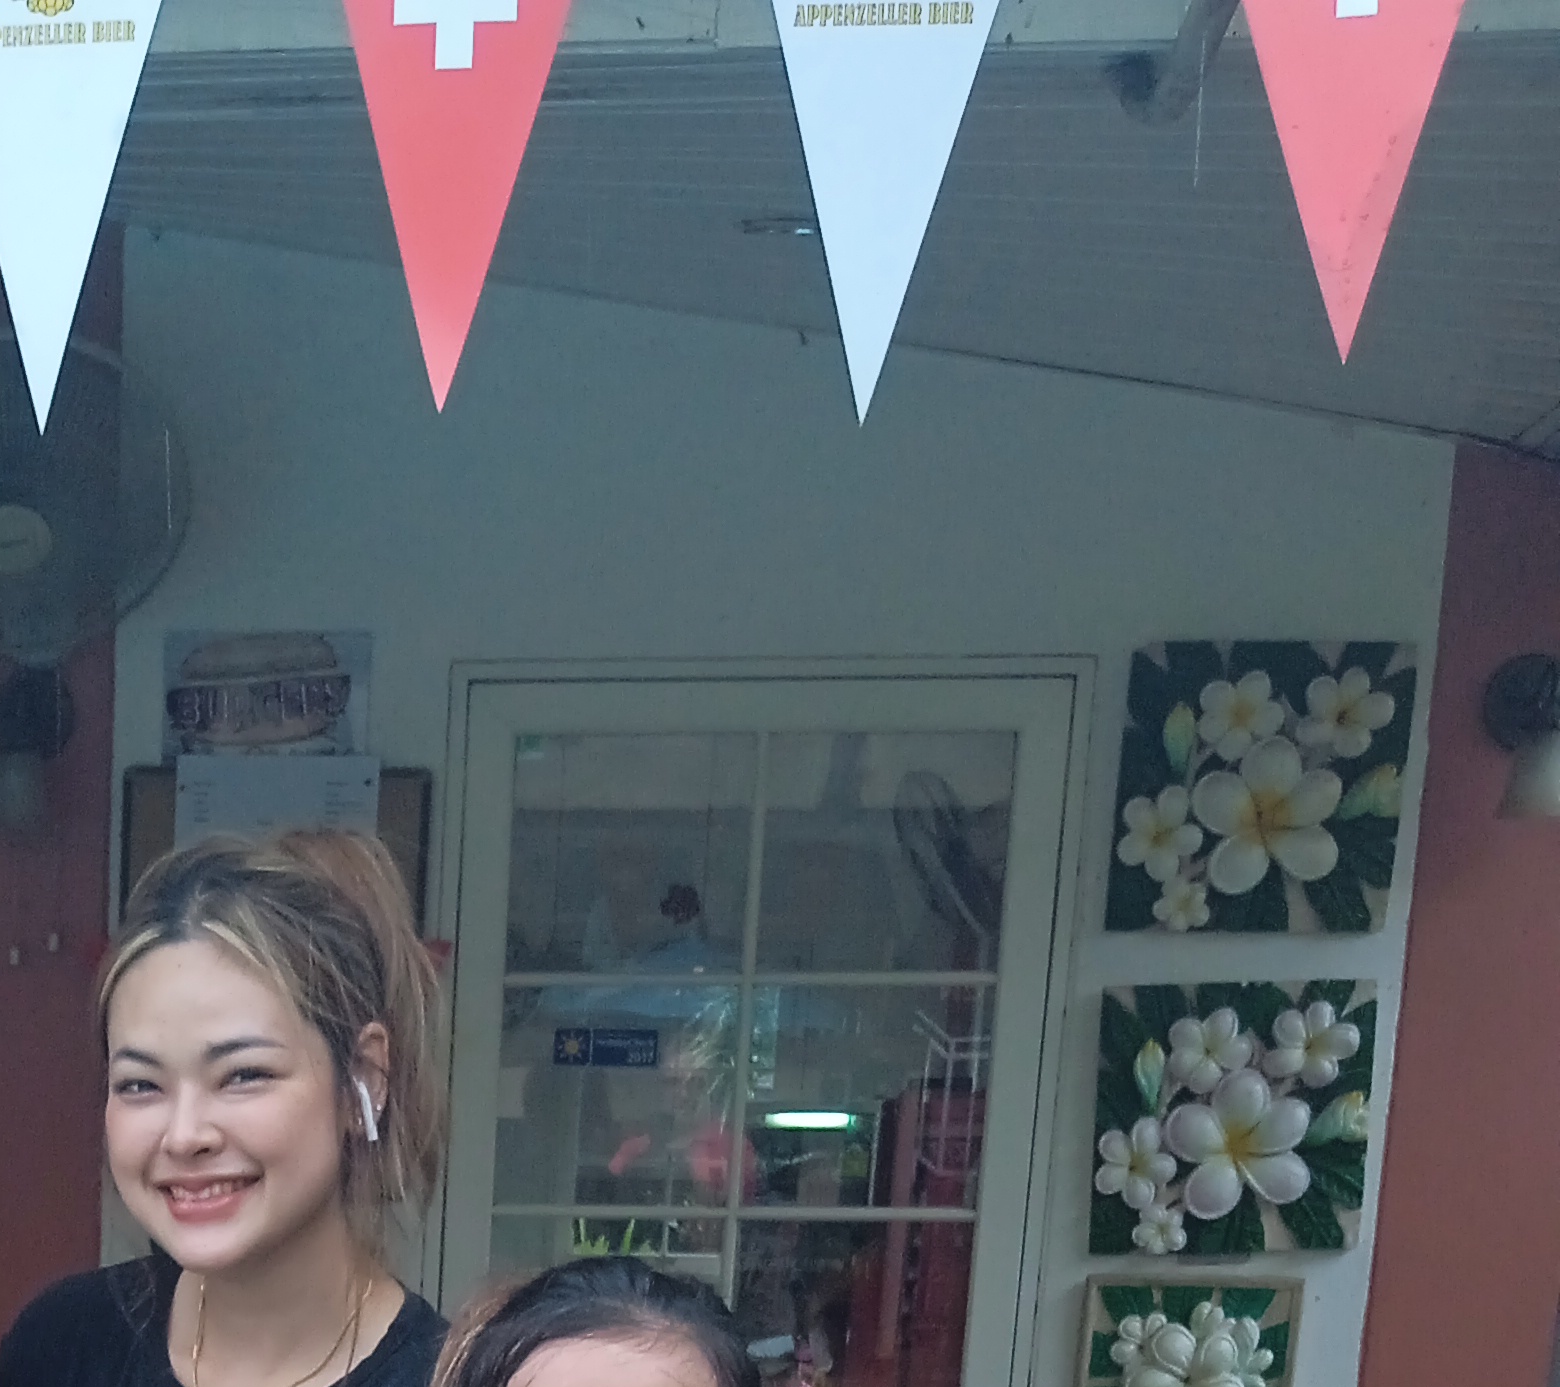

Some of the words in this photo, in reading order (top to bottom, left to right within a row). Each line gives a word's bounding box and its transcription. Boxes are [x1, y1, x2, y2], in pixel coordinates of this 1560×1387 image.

[794, 2, 922, 27] APPENZELLER
[928, 1, 974, 25] BIER
[92, 19, 136, 43] BIER
